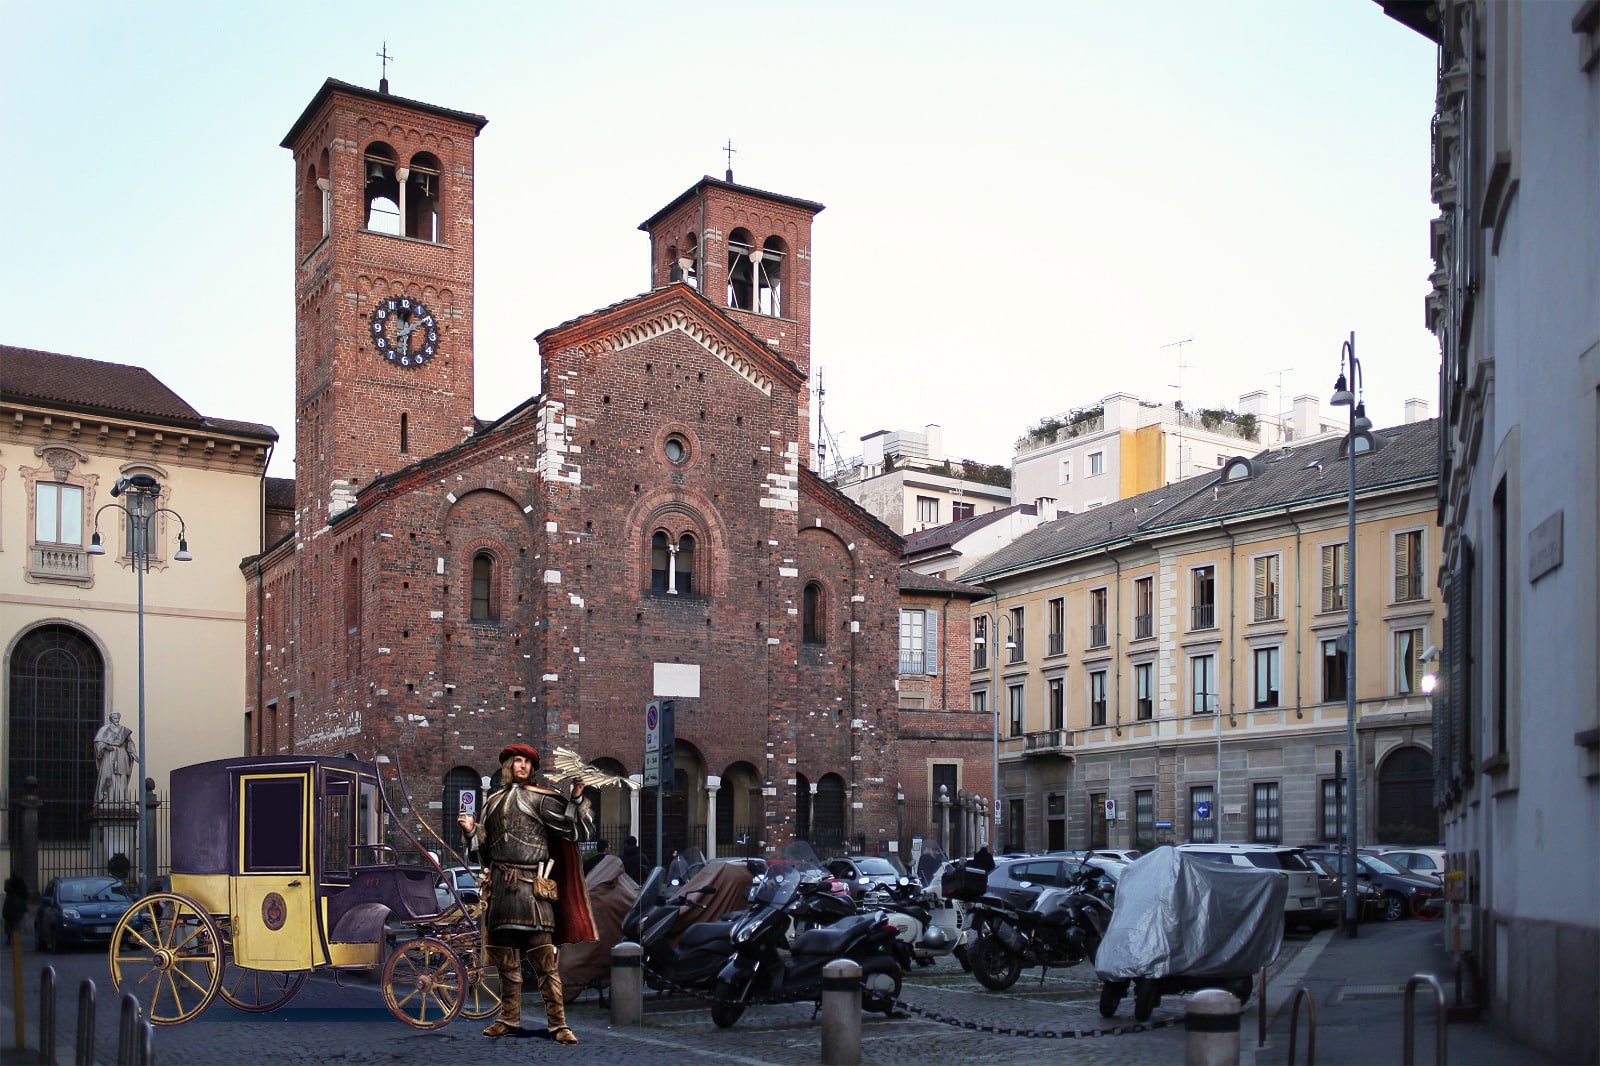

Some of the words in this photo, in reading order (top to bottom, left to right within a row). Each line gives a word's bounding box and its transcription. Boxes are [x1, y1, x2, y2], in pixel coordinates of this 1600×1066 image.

[388, 301, 395, 310] 11
[402, 299, 410, 308] 12
[378, 309, 386, 319] 10
[426, 318, 433, 327] 2
[374, 323, 382, 333] 9
[429, 332, 437, 342] 3
[377, 338, 385, 348] 8
[388, 350, 395, 360] 7
[425, 346, 434, 355] 4
[401, 356, 409, 366] 6
[415, 354, 423, 364] 5
